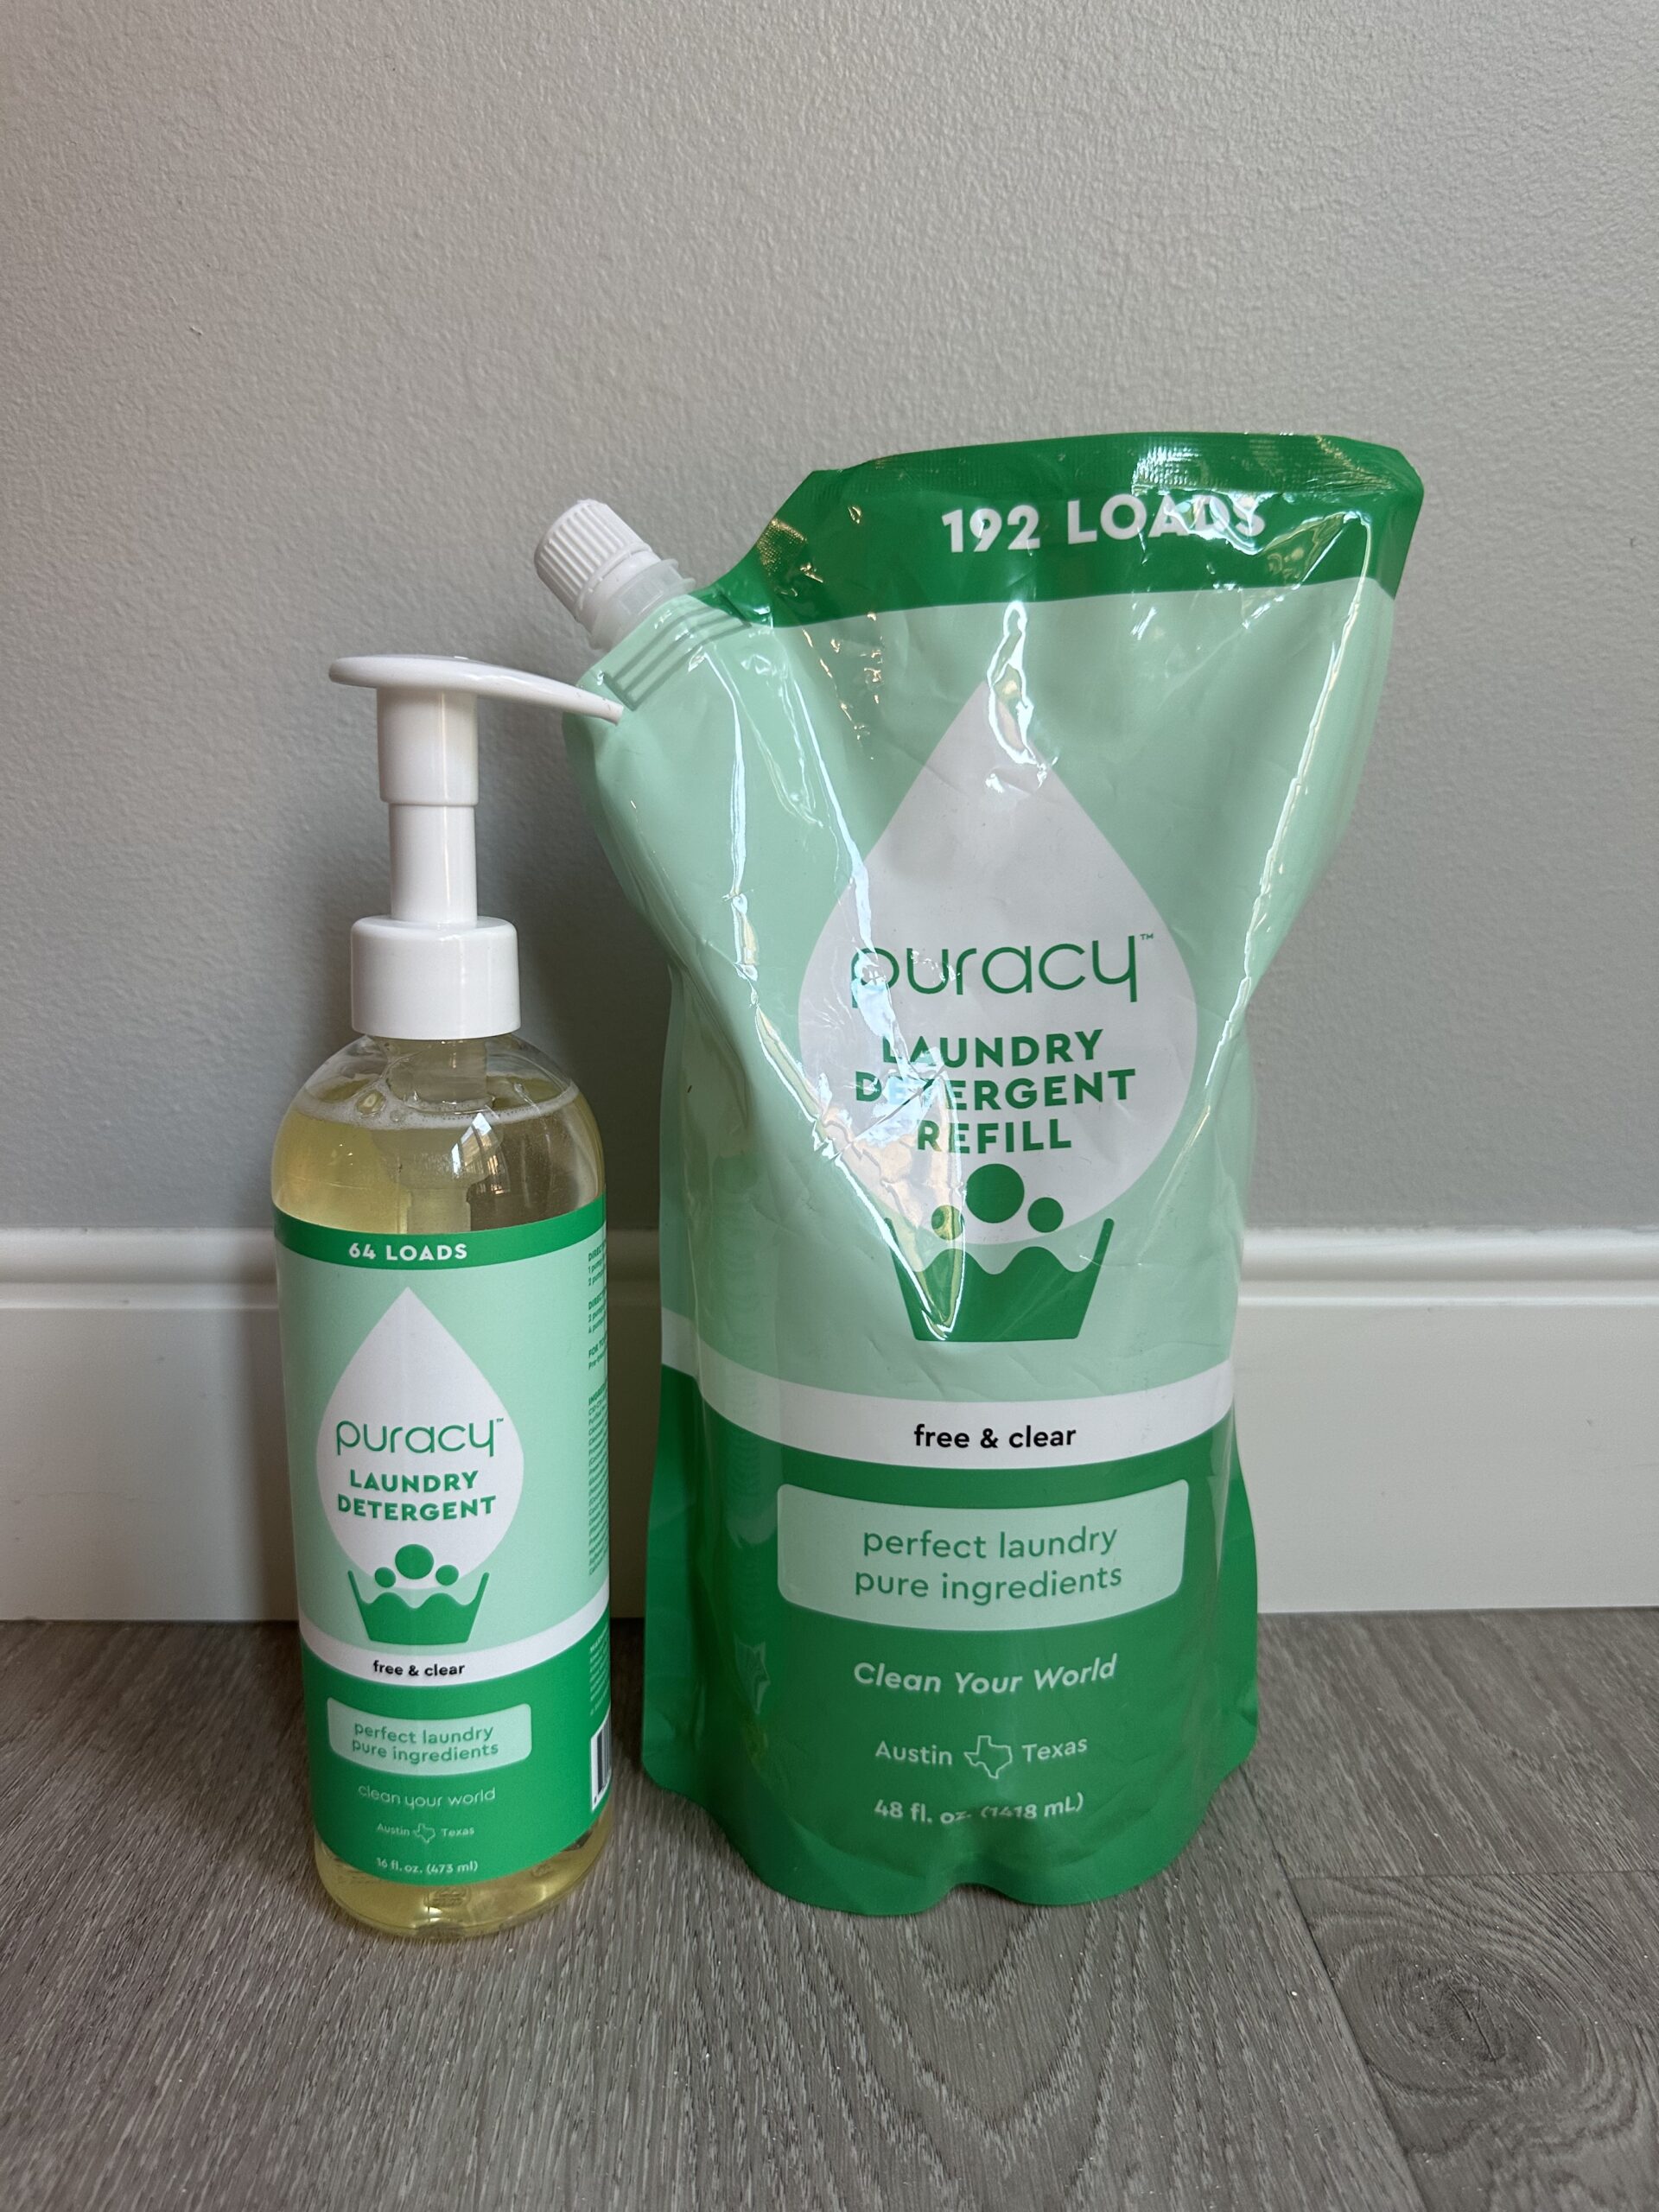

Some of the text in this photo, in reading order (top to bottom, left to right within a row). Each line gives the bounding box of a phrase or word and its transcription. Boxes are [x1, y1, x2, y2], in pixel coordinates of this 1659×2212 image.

[941, 493, 1267, 553] 192 LOADS
[883, 1028, 1104, 1070] LAUNDRY
[855, 1068, 1136, 1111] DEERGENT
[917, 1118, 1072, 1154] REFILL
[348, 1243, 468, 1262] 64 LOADS
[913, 1423, 1077, 1449] free & clear
[349, 1469, 479, 1493] LAUNDRY
[337, 1494, 497, 1521] DETERGENT
[862, 1525, 1118, 1559] perfect laundry
[855, 1566, 1122, 1605] pure ingredients
[372, 1660, 466, 1677] free & clear
[854, 1652, 1118, 1694] Clean Your World
[353, 1722, 495, 1745] perfect laundry
[352, 1738, 499, 1765] pure ingredients
[874, 1737, 1089, 1765] Austin Texas
[358, 1784, 497, 1809] clean your world
[874, 1798, 904, 1818] 48
[910, 1802, 933, 1825] fl.
[1043, 1791, 1085, 1817] mL)
[377, 1821, 475, 1837] Austin Texas
[376, 1857, 389, 1869] 16
[426, 1862, 454, 1876] (473
[456, 1859, 479, 1873] ml)
